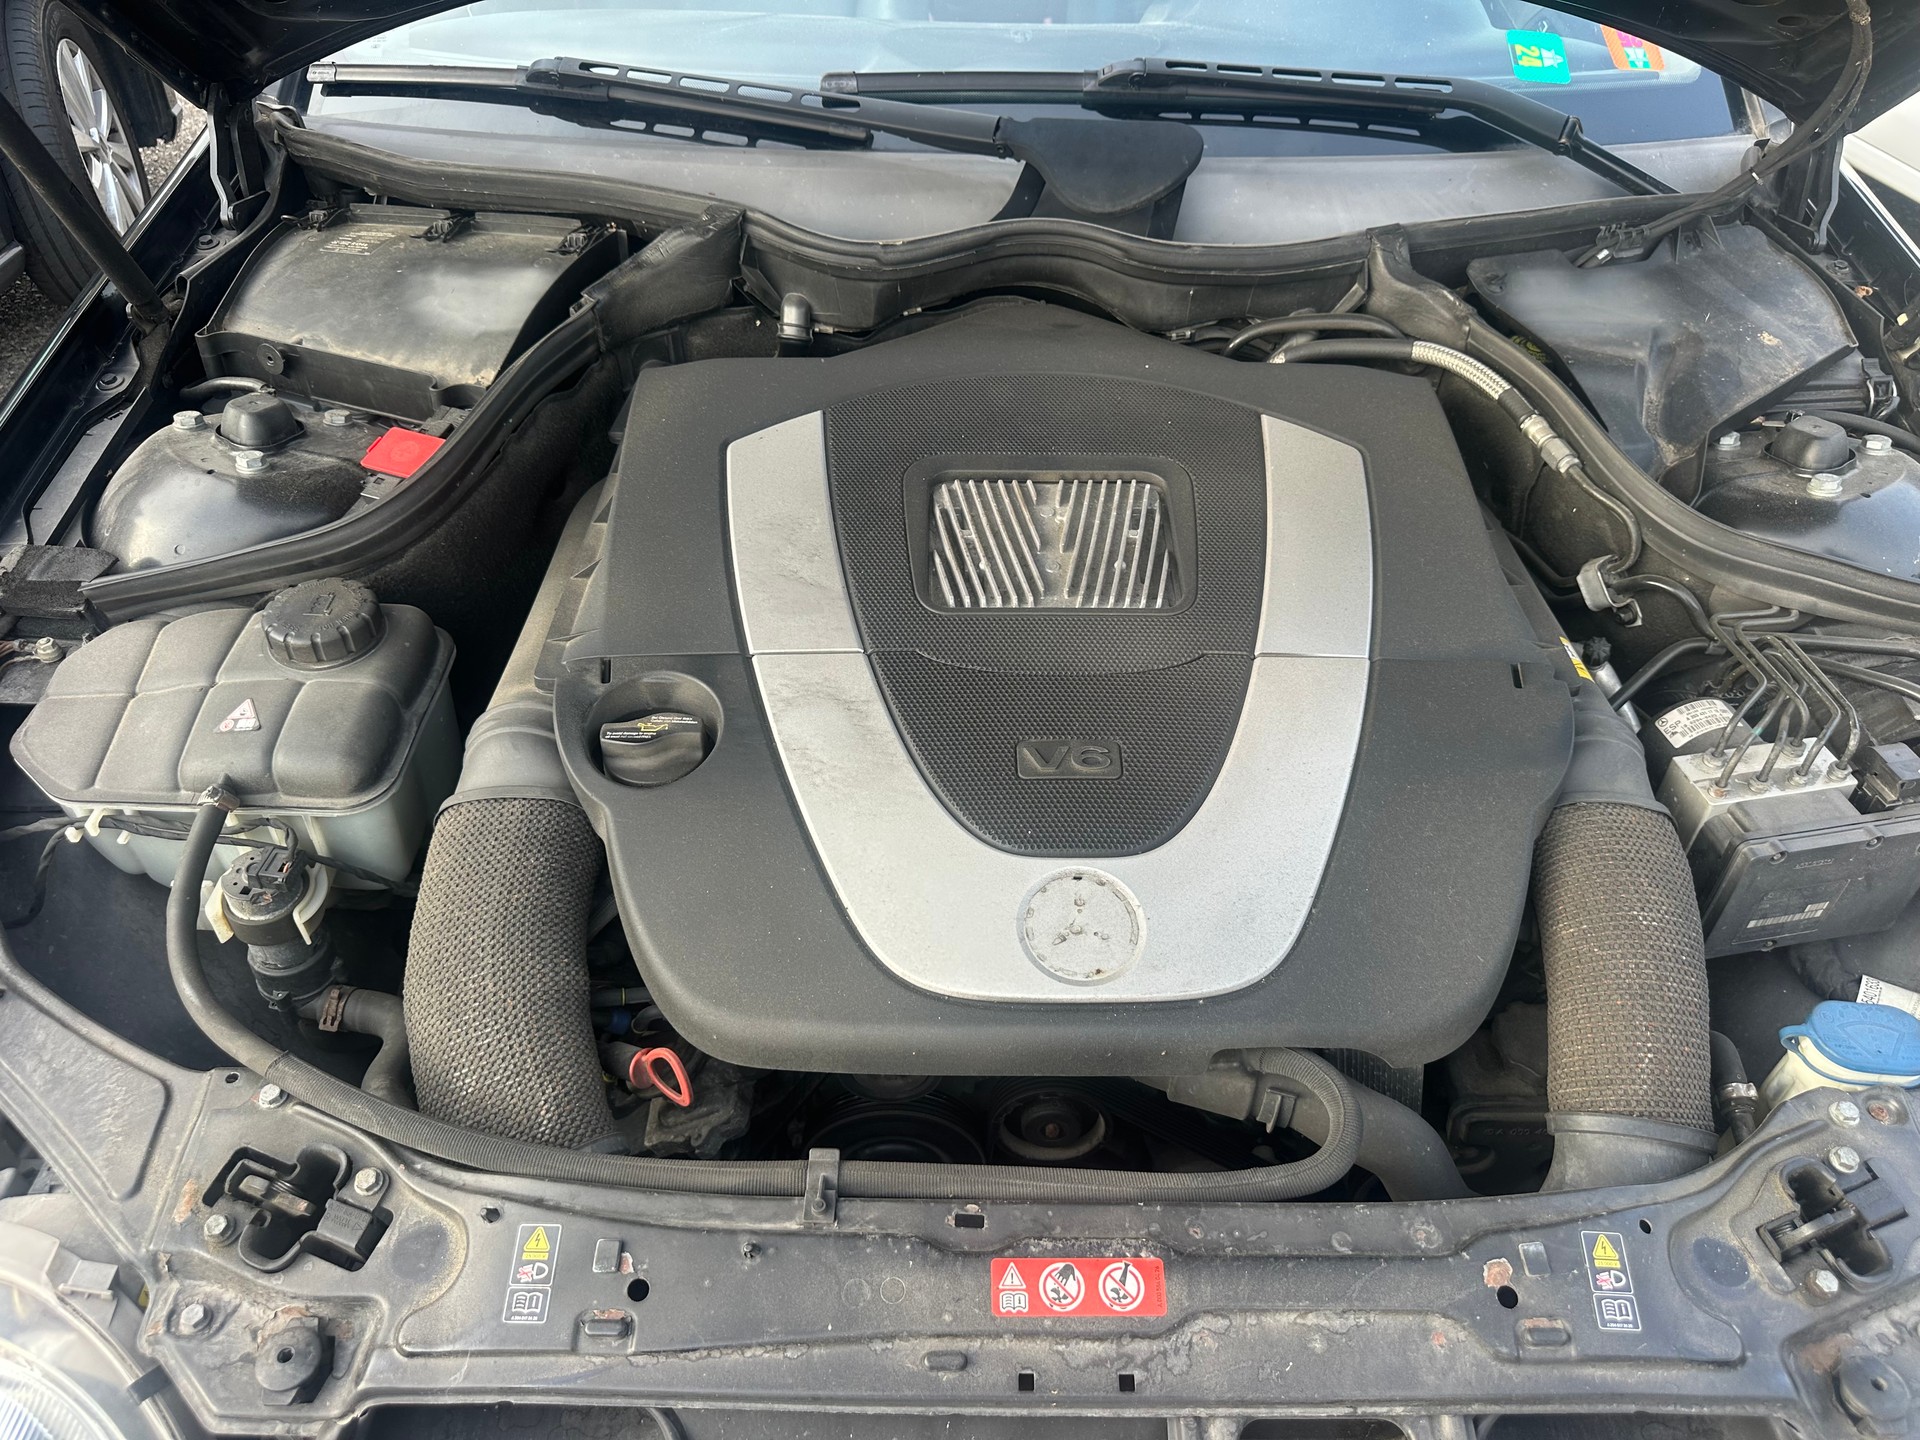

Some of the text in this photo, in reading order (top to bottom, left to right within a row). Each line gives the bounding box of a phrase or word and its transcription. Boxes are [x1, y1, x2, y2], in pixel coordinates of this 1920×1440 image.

[1515, 43, 1543, 67] 24
[1663, 720, 1681, 735] ESP
[1023, 745, 1111, 772] V6
